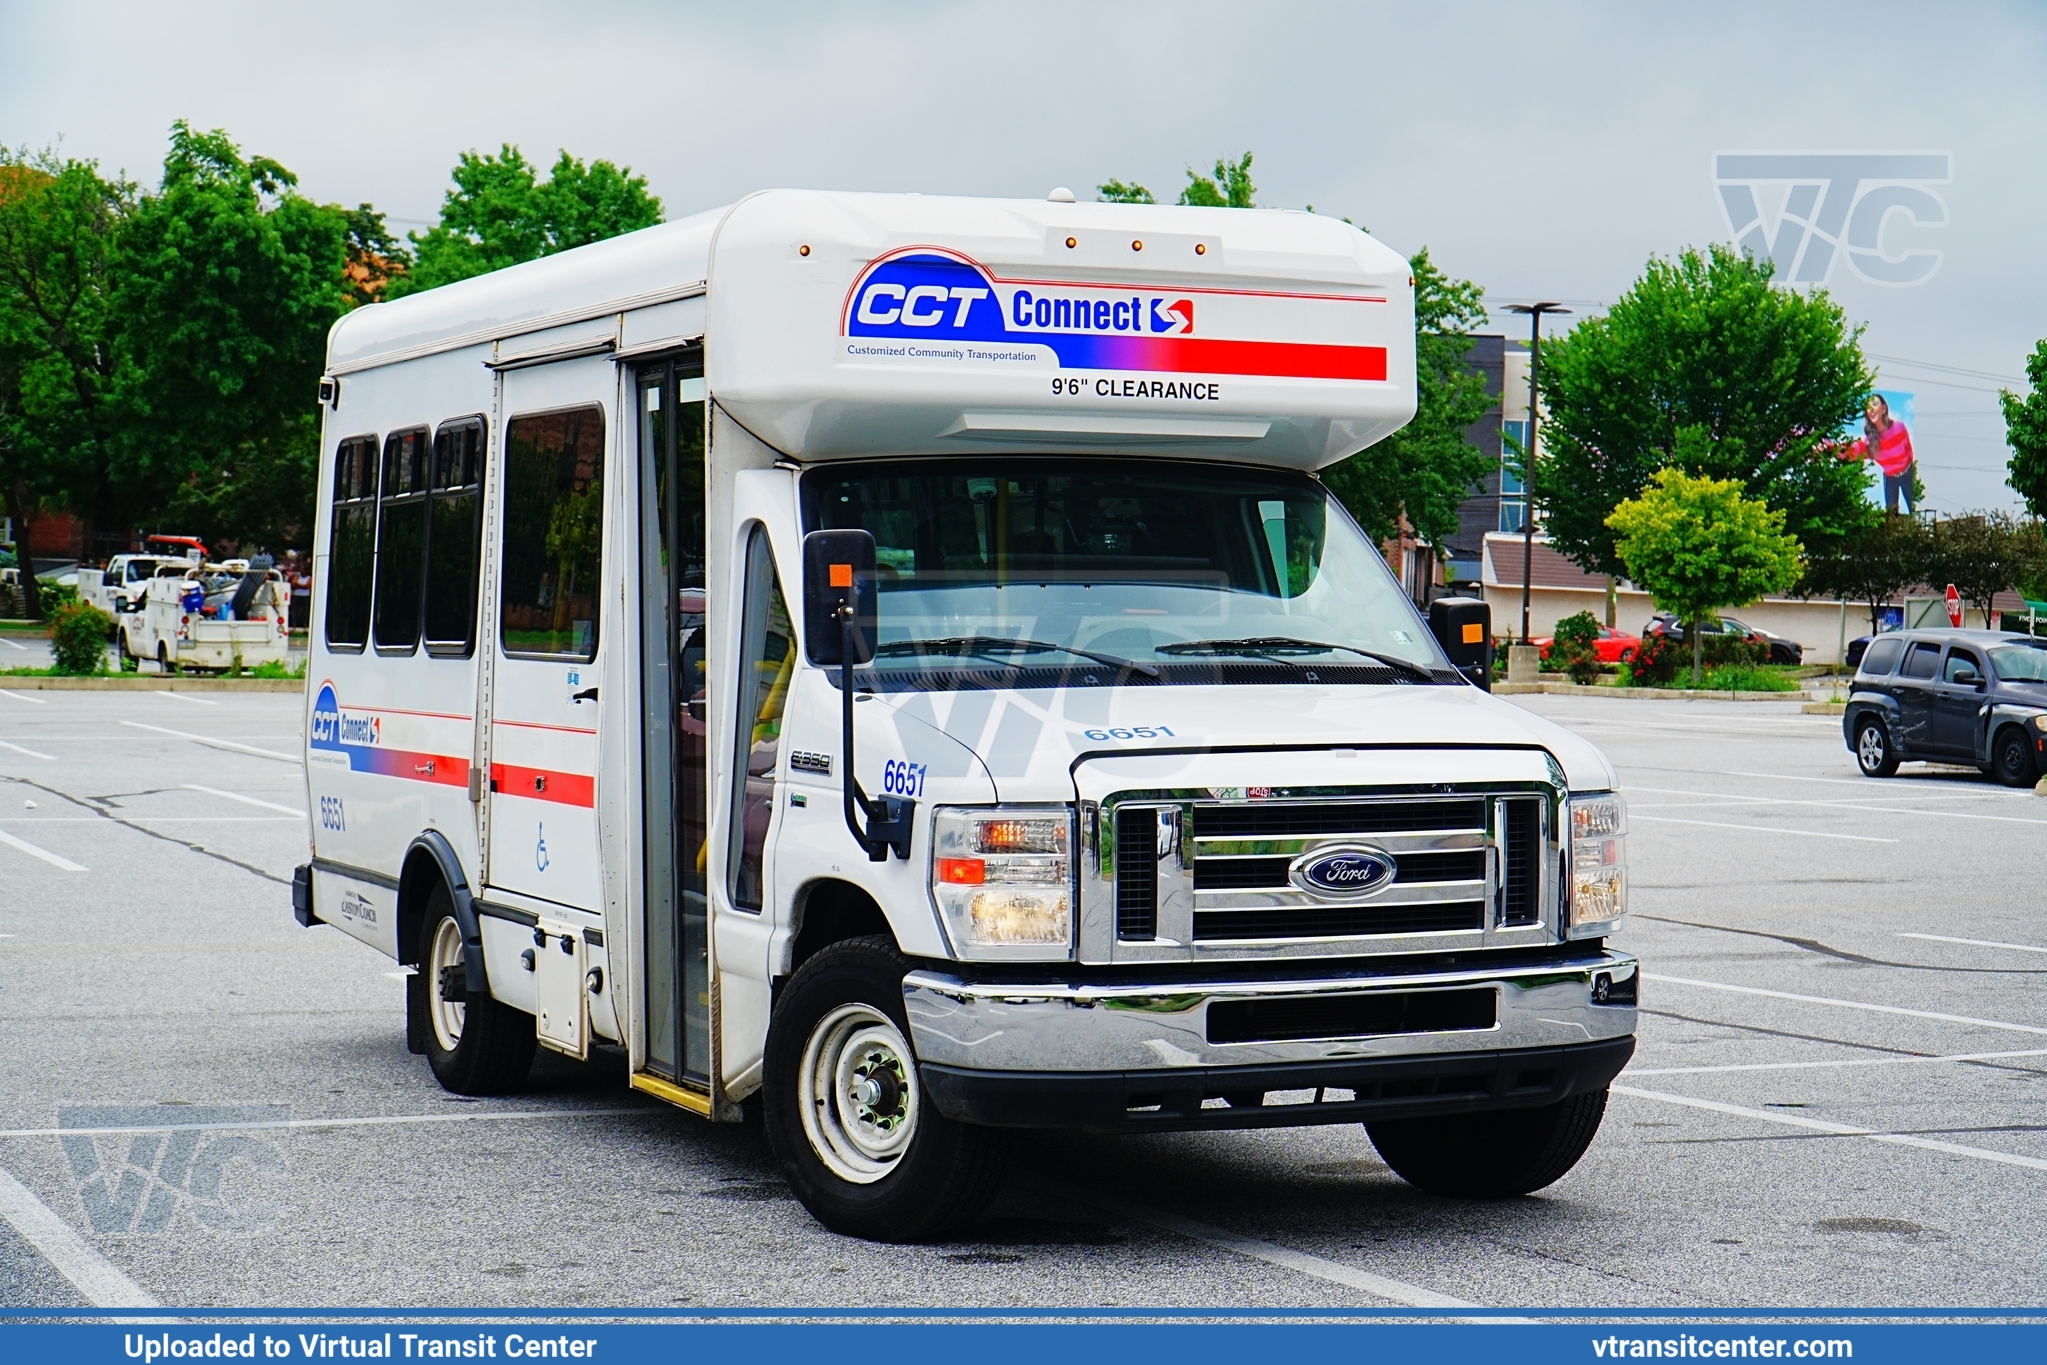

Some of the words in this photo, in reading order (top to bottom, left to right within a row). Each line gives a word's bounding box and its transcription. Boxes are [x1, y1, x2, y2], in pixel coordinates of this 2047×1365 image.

[857, 283, 989, 328] CCT
[1012, 289, 1142, 332] Connect
[847, 345, 906, 356] Customized
[908, 347, 965, 361] Community
[967, 349, 1037, 362] Transportation
[1051, 378, 1089, 396] 9'6"
[1095, 379, 1220, 401] CLEARANCE
[1947, 598, 1960, 616] STOP
[312, 710, 338, 742] CCT
[341, 713, 369, 743] Connect
[1083, 725, 1176, 742] 6651
[884, 759, 927, 797] 6651
[320, 795, 346, 832] 6651
[1326, 859, 1371, 882] Ford
